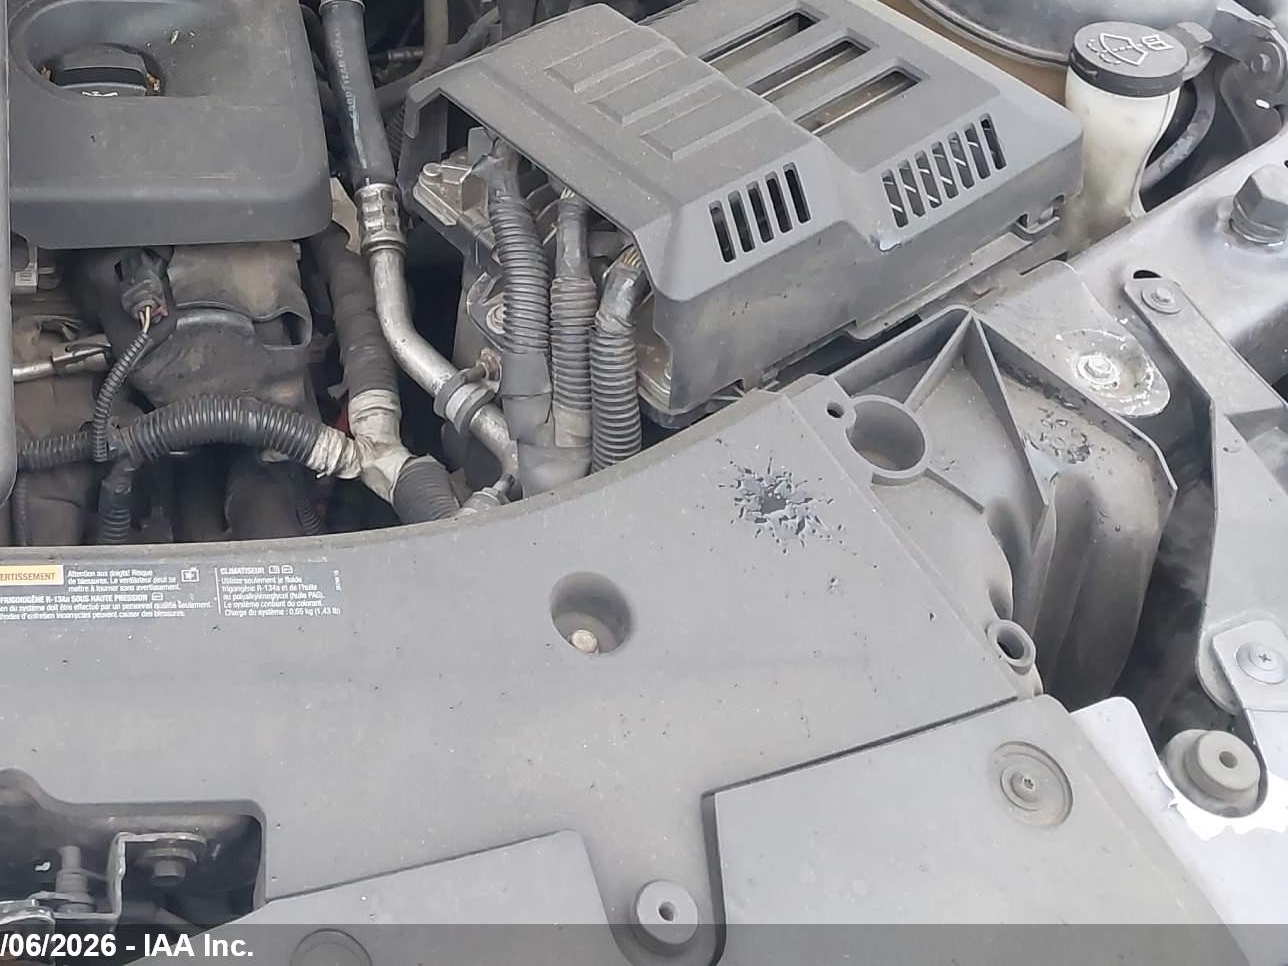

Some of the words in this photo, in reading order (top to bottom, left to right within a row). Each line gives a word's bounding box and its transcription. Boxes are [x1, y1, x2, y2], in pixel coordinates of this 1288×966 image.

[67, 569, 96, 578] Attention
[96, 570, 109, 578] aux
[220, 567, 265, 575] CLIMATISEUR
[45, 595, 71, 604] R-134a
[71, 594, 90, 603] SOUS
[90, 594, 114, 603] HAUTE
[114, 593, 148, 602] PRESSION
